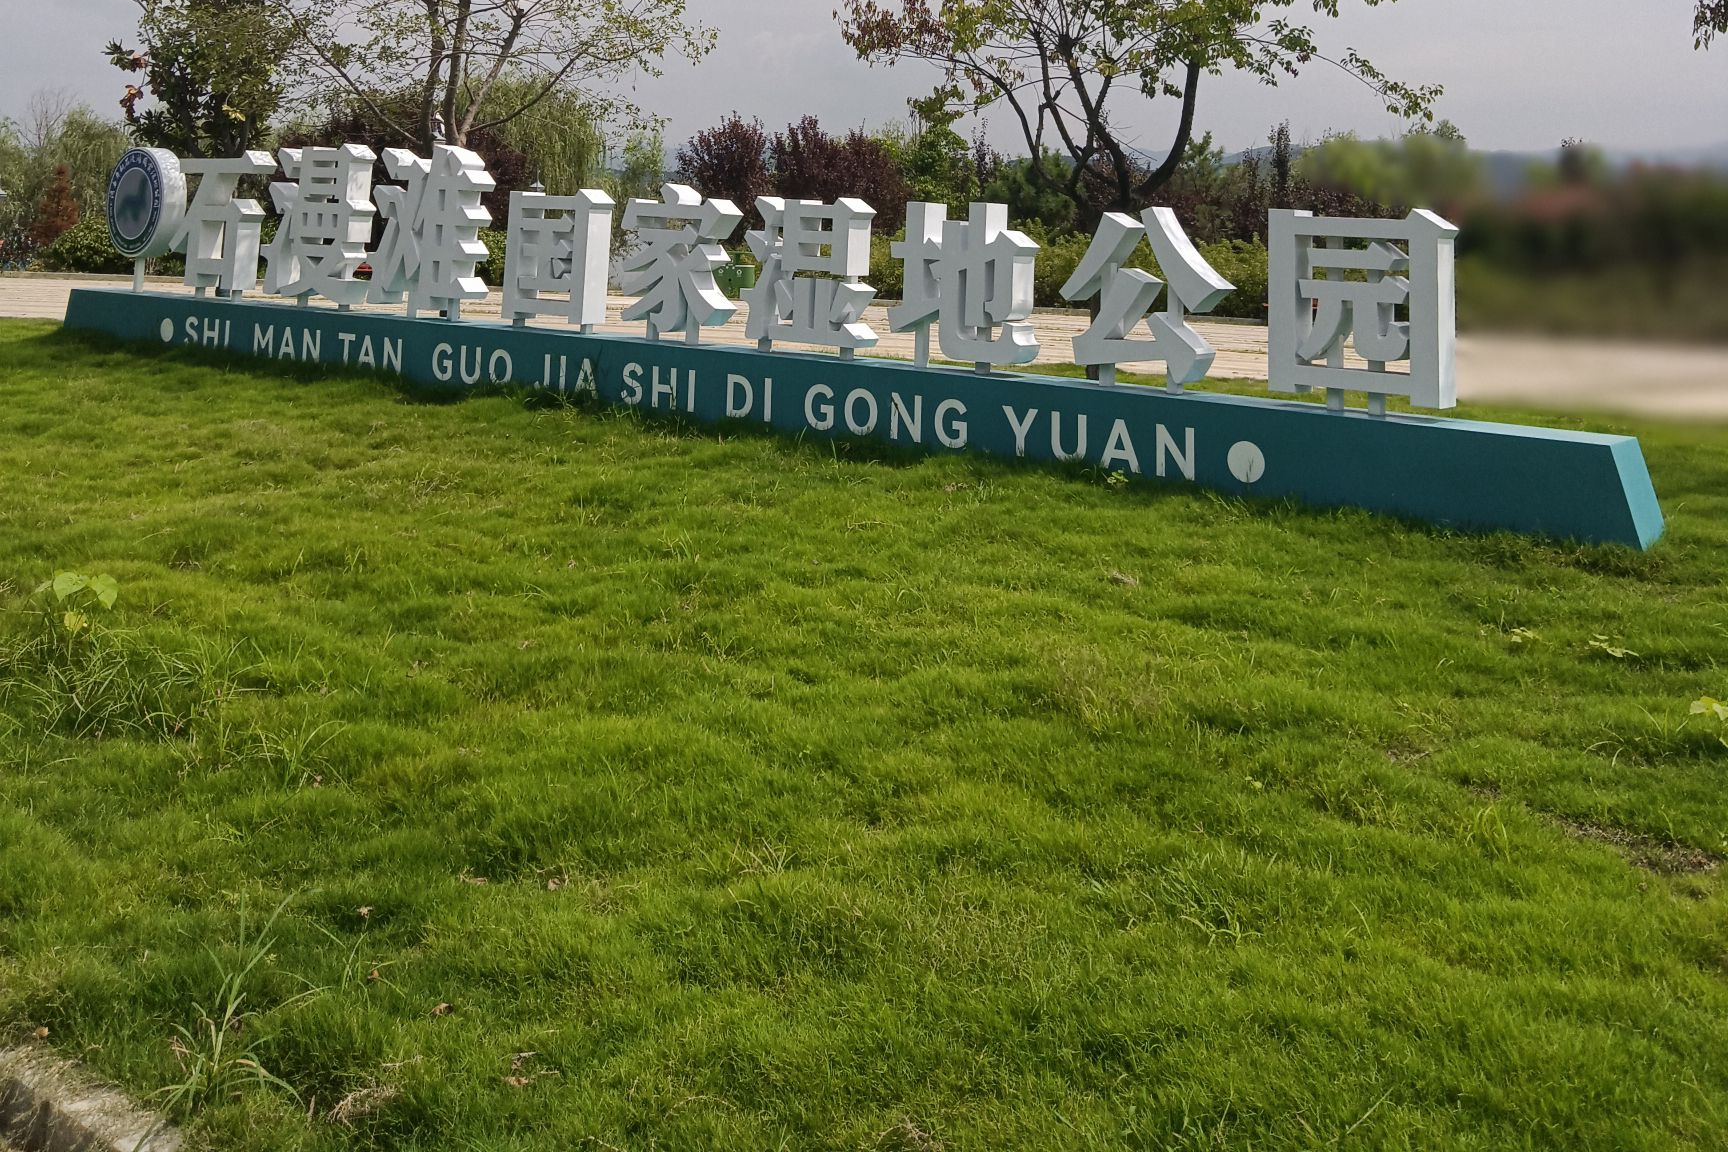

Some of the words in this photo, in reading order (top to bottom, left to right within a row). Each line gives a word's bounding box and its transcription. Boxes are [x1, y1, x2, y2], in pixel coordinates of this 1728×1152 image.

[169, 143, 1458, 409] 石漫滩国家湿地公园
[184, 315, 231, 347] SHI
[253, 323, 321, 363] MAN
[338, 332, 403, 376] TAN
[432, 343, 513, 385] GUO
[534, 353, 599, 399] JIA
[620, 362, 697, 413] SHI
[726, 373, 773, 423] DI
[804, 383, 968, 449] GONG
[1002, 405, 1195, 481] YUAN
